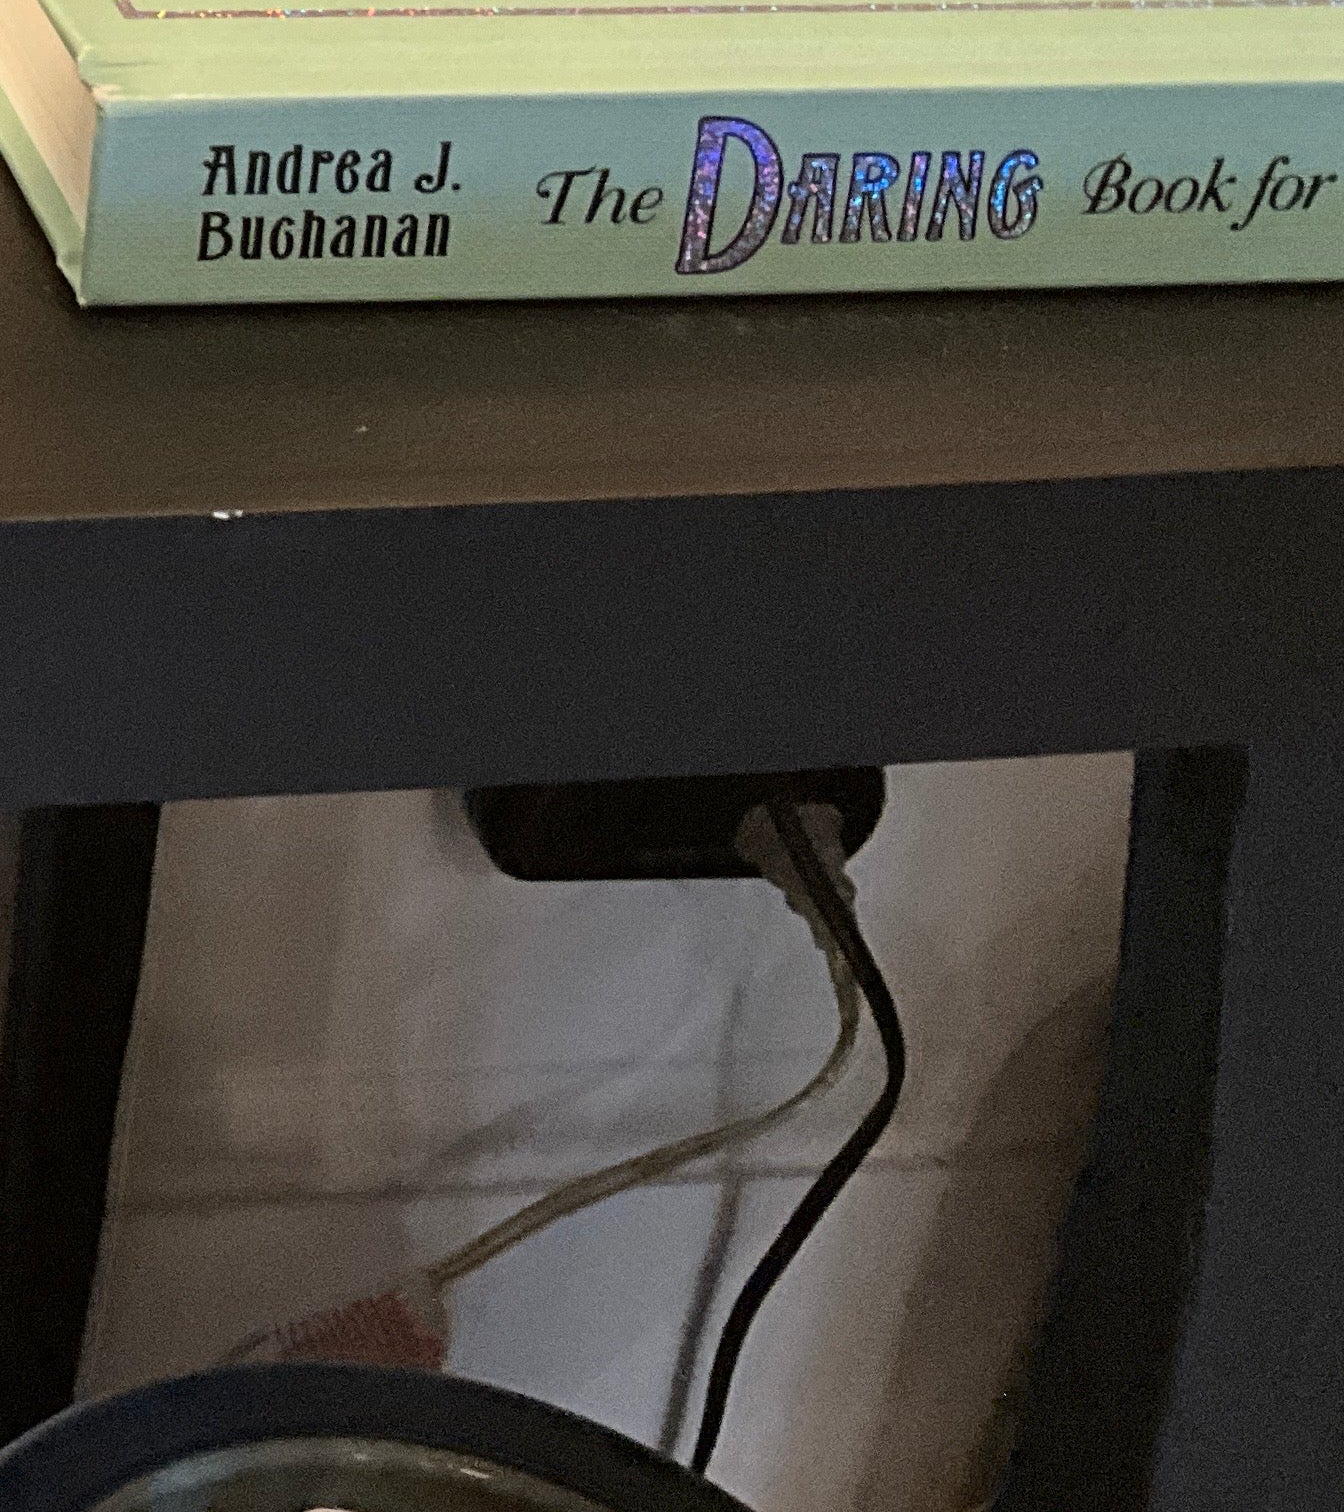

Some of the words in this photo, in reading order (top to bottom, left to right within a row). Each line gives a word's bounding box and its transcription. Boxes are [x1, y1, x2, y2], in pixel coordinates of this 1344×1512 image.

[201, 144, 394, 197] Andrea
[414, 141, 462, 194] J.
[535, 164, 665, 226] The
[675, 115, 1045, 275] DARING
[1082, 154, 1233, 217] Book
[1228, 153, 1342, 233] for
[197, 210, 451, 262] Buchanan
